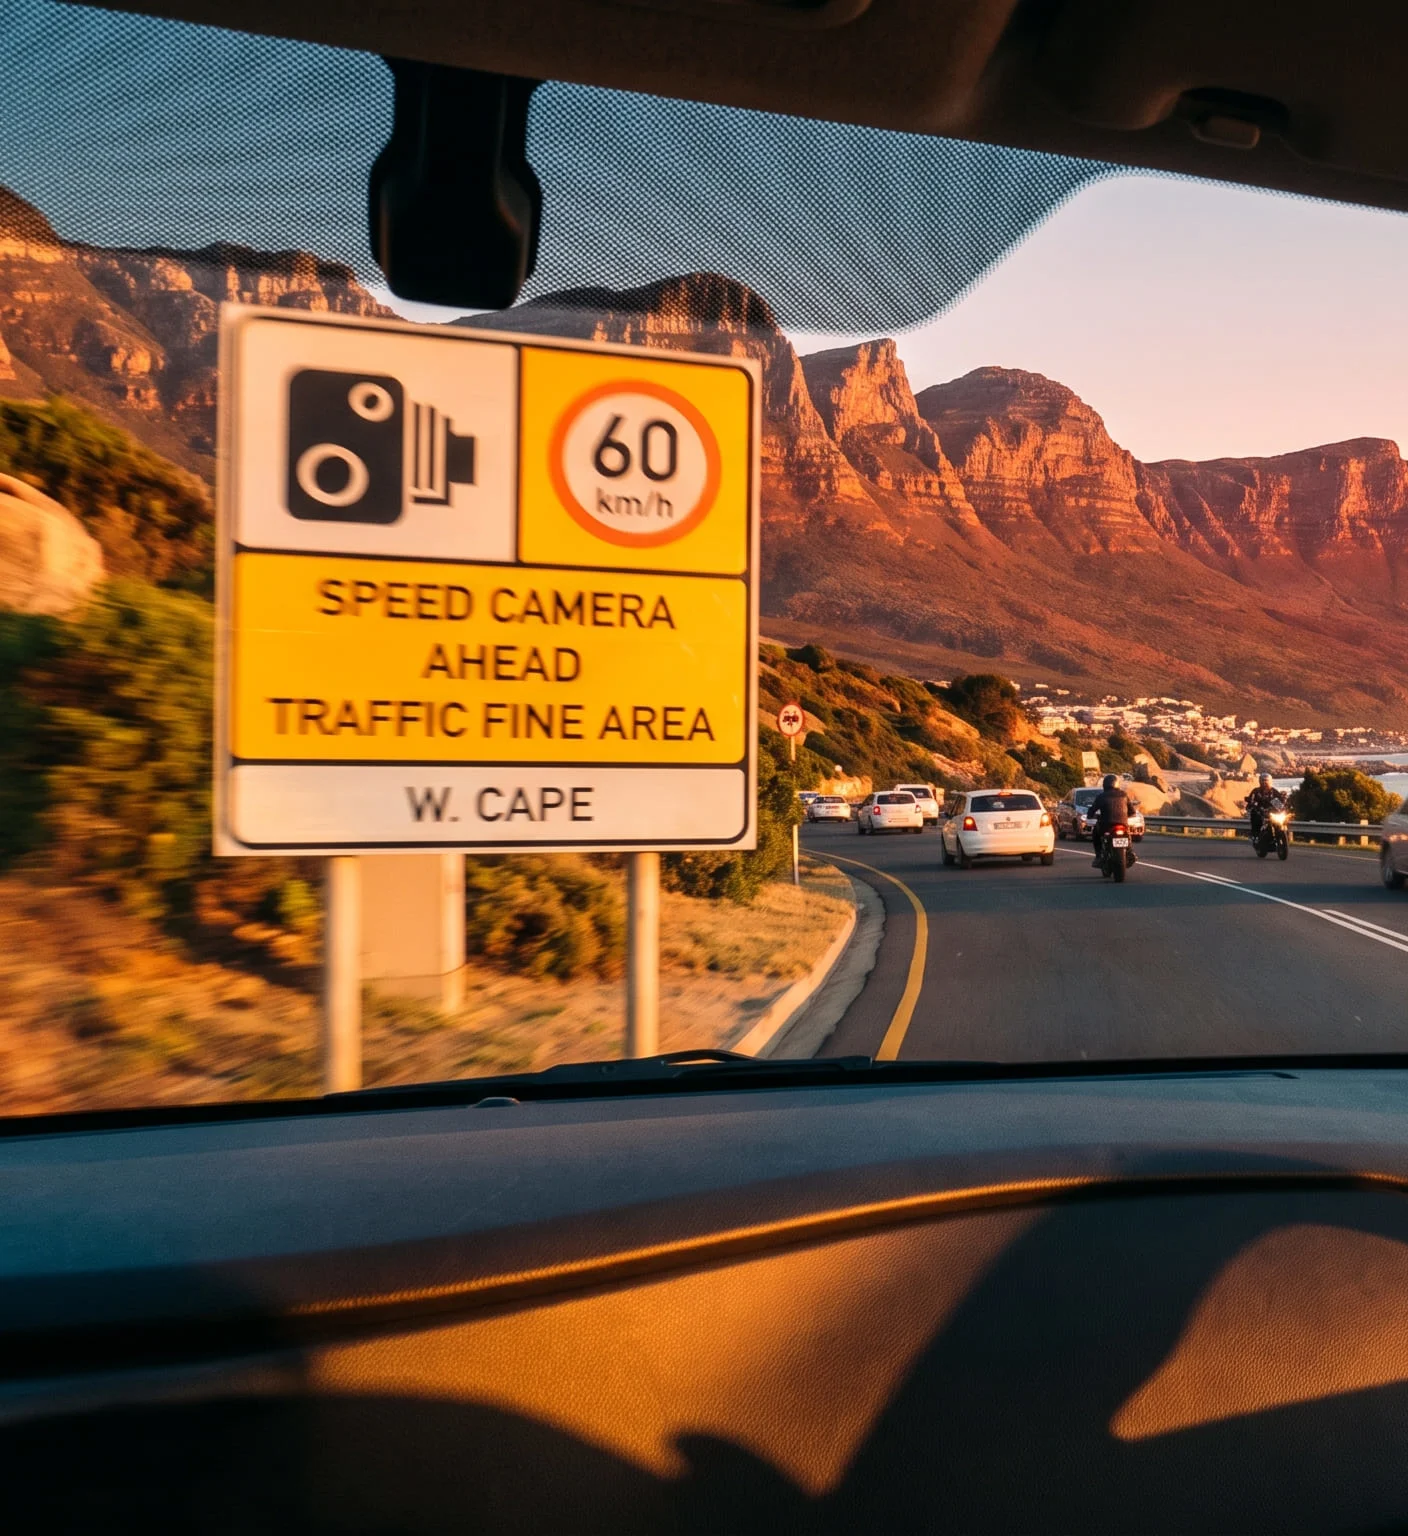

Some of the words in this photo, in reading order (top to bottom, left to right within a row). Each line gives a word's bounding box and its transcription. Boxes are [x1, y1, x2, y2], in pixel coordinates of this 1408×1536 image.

[592, 412, 679, 484] 60
[595, 488, 674, 519] km/h
[316, 579, 474, 621] SPEED
[490, 588, 676, 630] CAMERA
[421, 643, 582, 683] AHEAD
[266, 698, 468, 738] TRAFFIC
[482, 703, 584, 740] FINE
[598, 707, 716, 742] AREA
[404, 786, 460, 823] W.
[475, 786, 595, 823] CAPE
